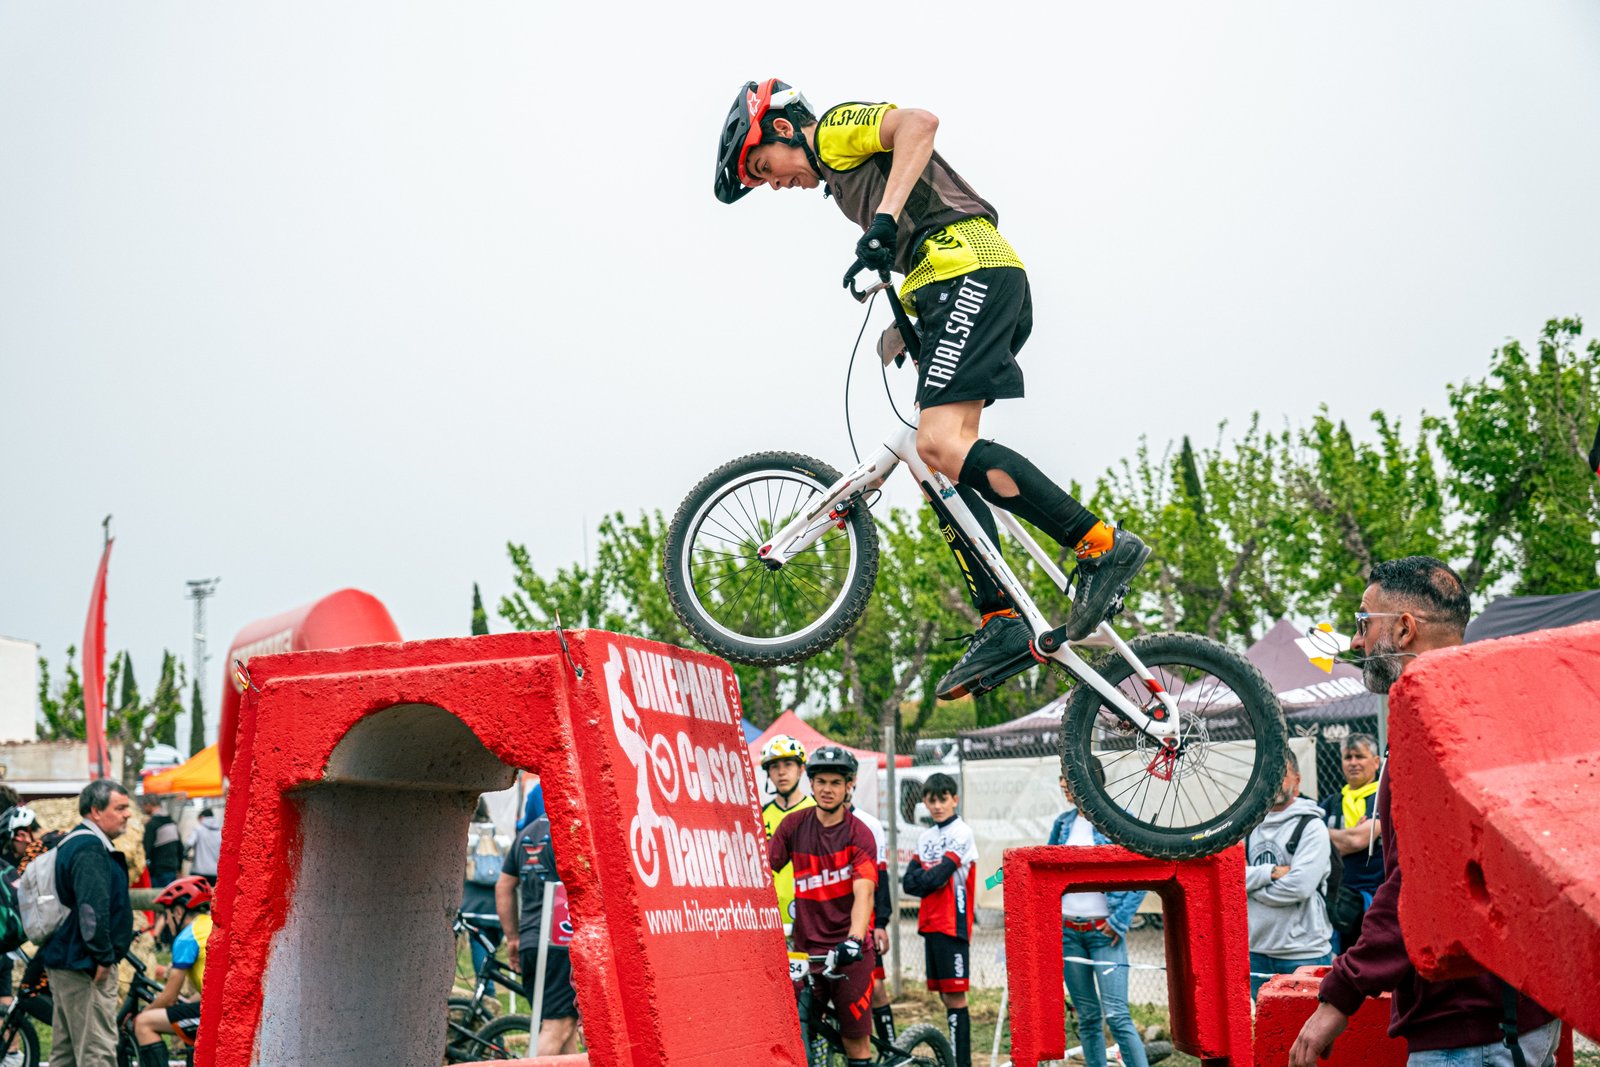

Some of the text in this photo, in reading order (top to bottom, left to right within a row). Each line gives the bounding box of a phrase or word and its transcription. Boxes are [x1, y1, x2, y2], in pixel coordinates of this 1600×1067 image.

[924, 275, 988, 389] TRIALSPORT
[625, 646, 732, 724] BIKEPARK
[676, 731, 748, 806] Costa
[659, 815, 764, 888] Daurada
[645, 899, 781, 938] www.bikeparktdb.com
